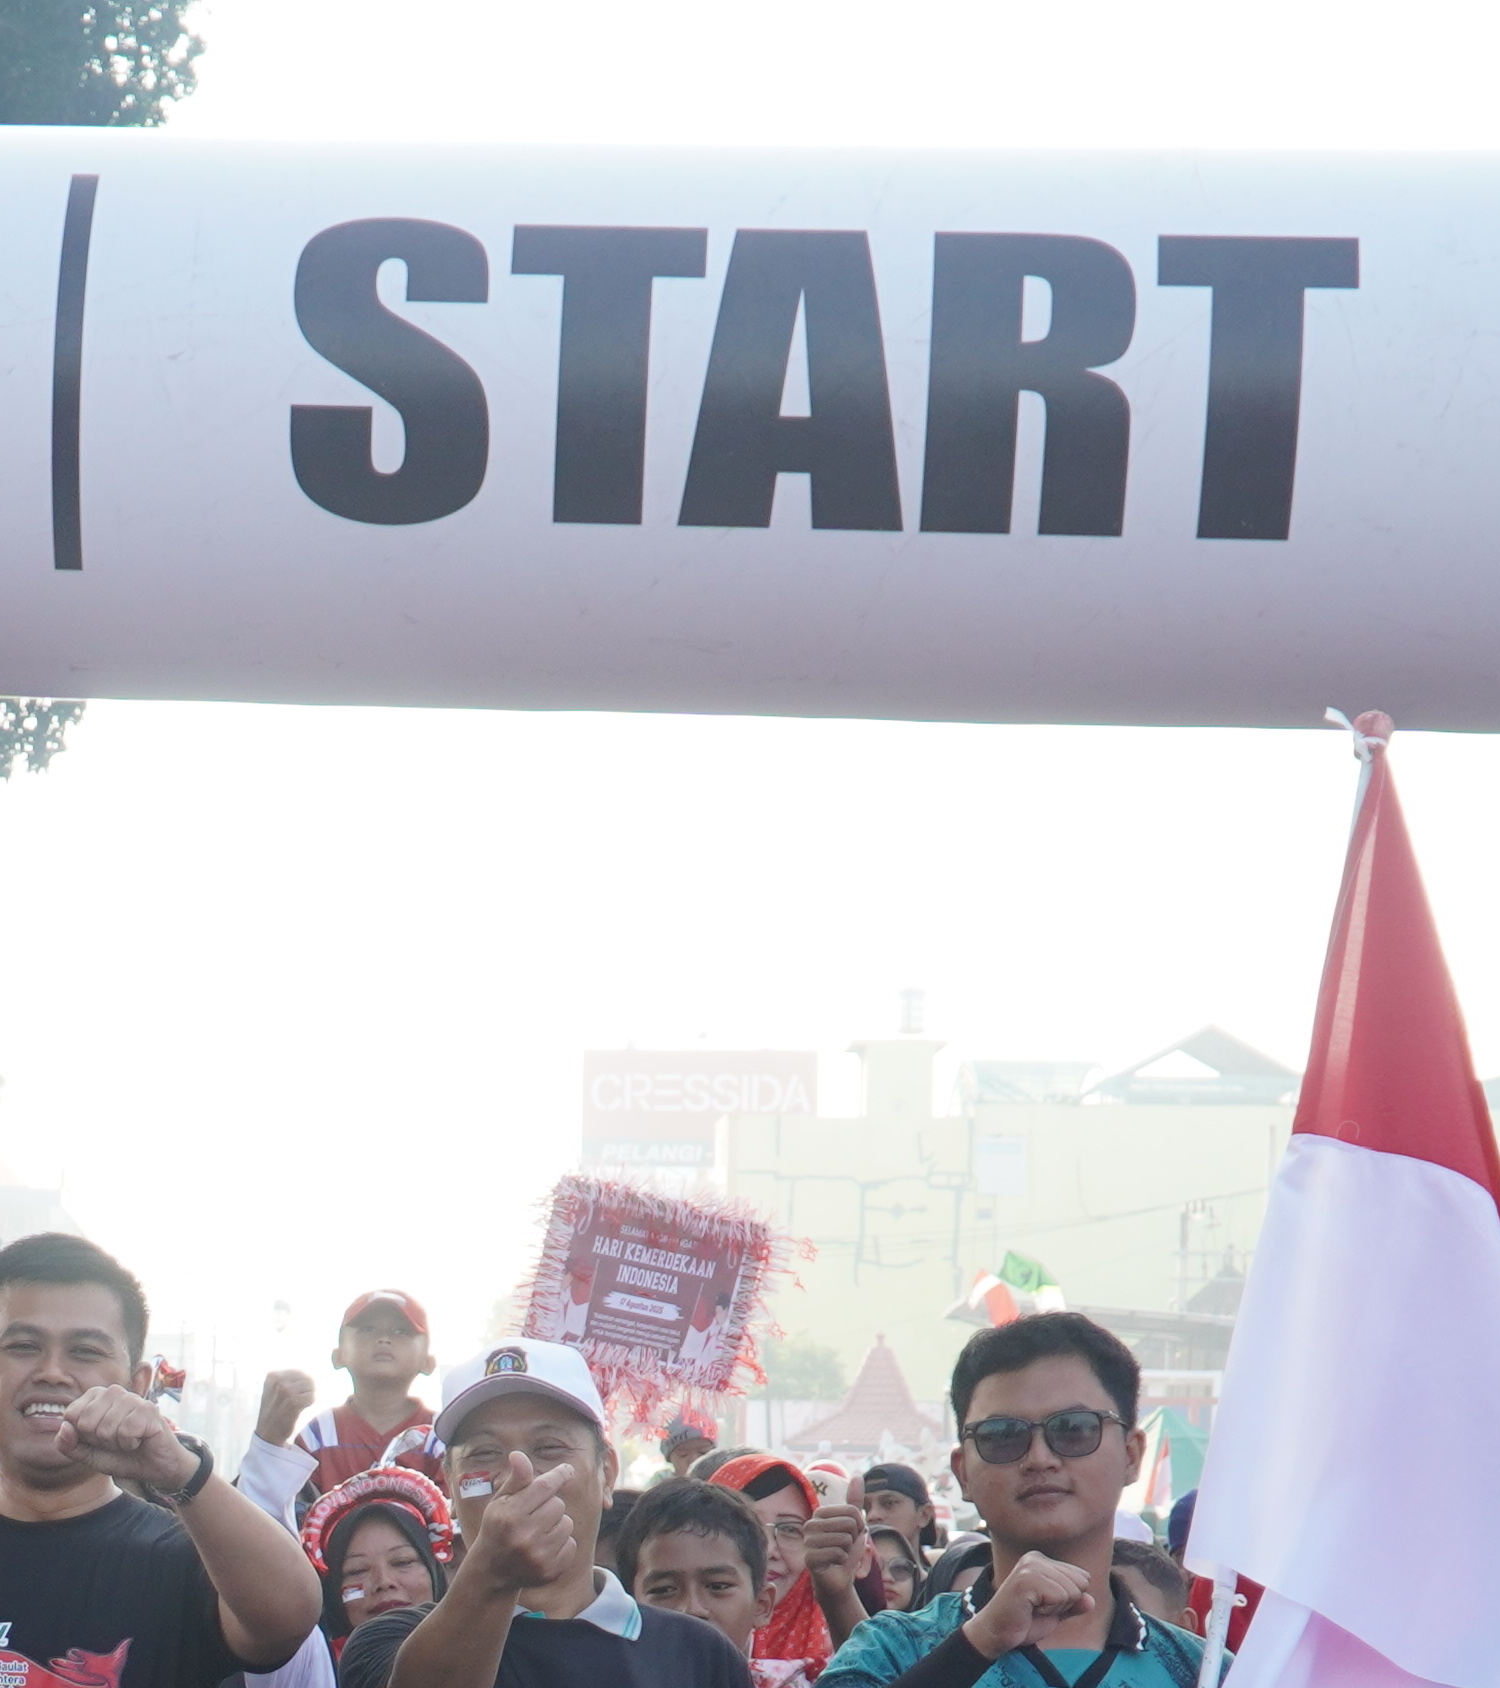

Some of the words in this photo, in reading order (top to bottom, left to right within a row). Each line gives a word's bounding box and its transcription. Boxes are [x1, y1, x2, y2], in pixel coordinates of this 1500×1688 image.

[288, 215, 1362, 542] START
[590, 1072, 812, 1113] CRESSIDA
[601, 1143, 704, 1163] PELANGI
[592, 1234, 624, 1260] HARI
[623, 1241, 717, 1280] KEMERDEKAAN
[615, 1264, 680, 1295] INDONESIA
[344, 1475, 439, 1518] INDONESIA
